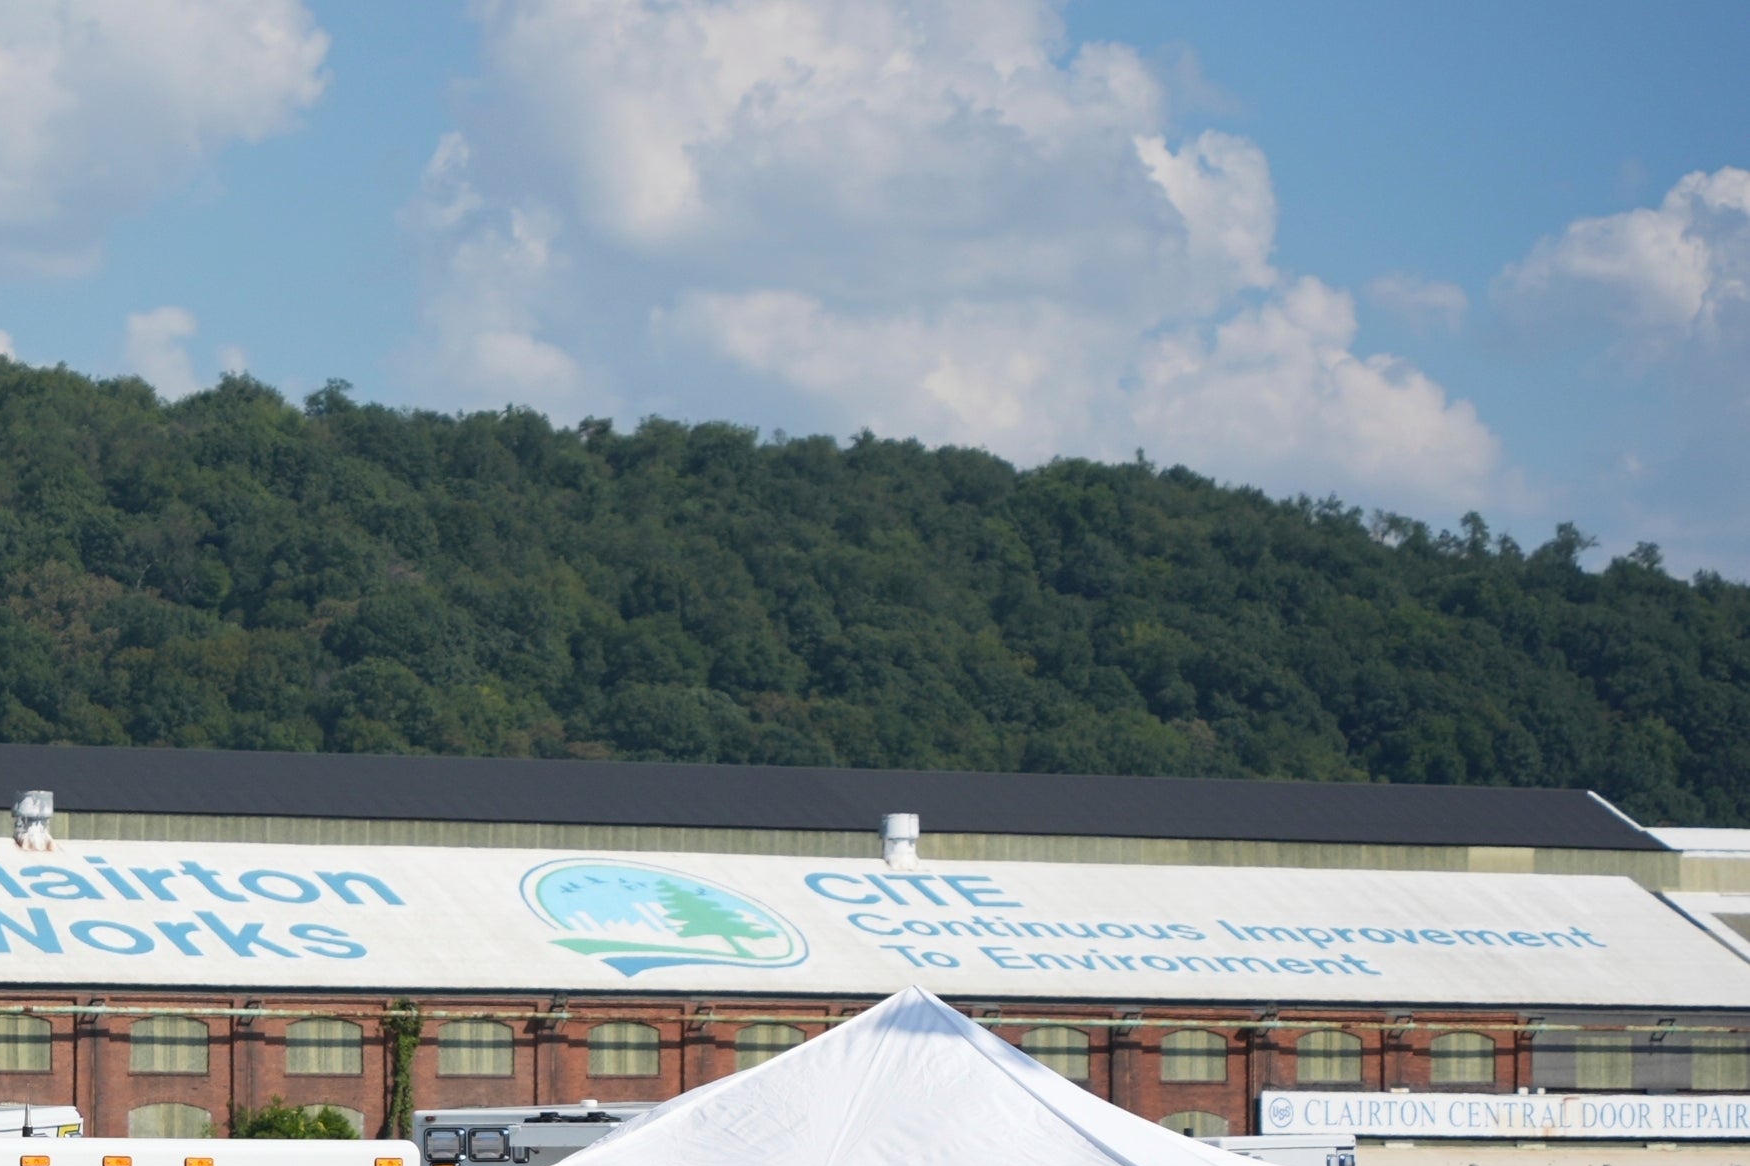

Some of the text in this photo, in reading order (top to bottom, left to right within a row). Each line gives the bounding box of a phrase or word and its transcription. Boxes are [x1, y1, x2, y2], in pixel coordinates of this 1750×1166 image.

[803, 871, 1024, 908] CITE
[847, 912, 1608, 950] Continuous Improvement
[879, 944, 1382, 976] To Environment
[1303, 1100, 1750, 1131] CLAIRTON CENTRAL DOOR REPAIR
